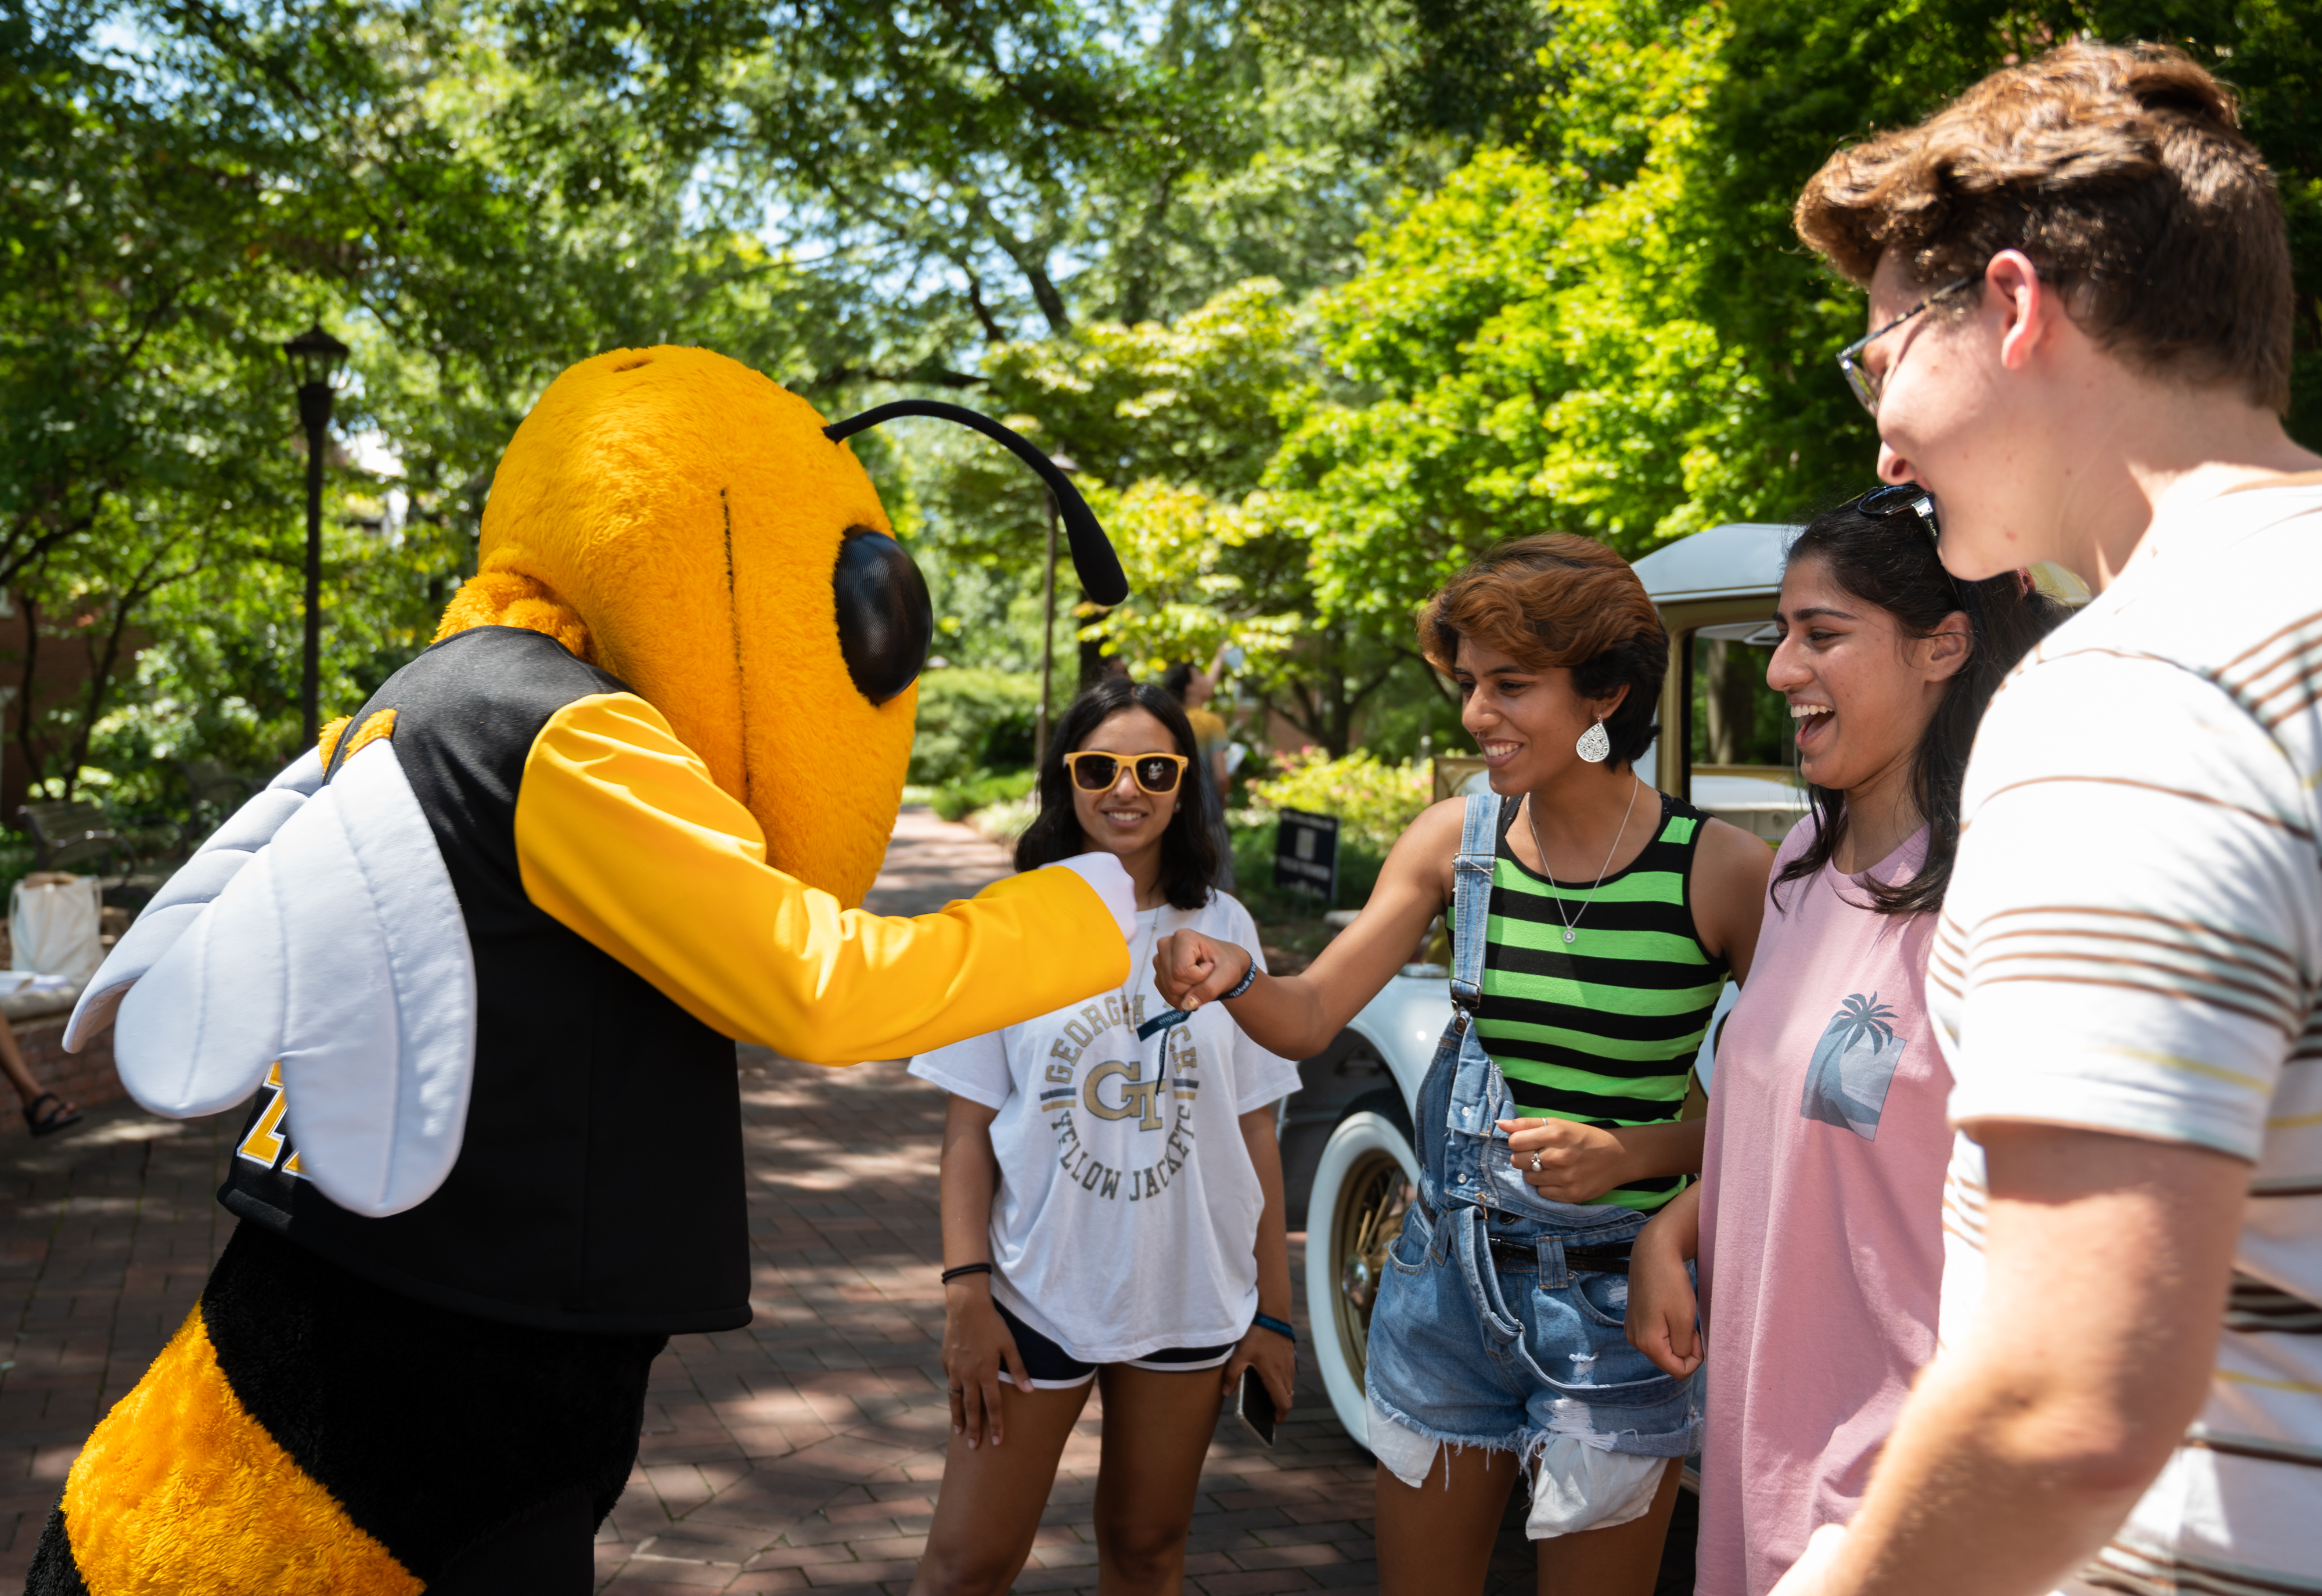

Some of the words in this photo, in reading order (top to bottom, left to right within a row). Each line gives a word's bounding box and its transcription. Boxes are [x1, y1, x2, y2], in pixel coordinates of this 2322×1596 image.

[1928, 519, 1938, 536] RALPH
[1083, 1060, 1165, 1132] GT
[1051, 1109, 1121, 1200] YELLOW
